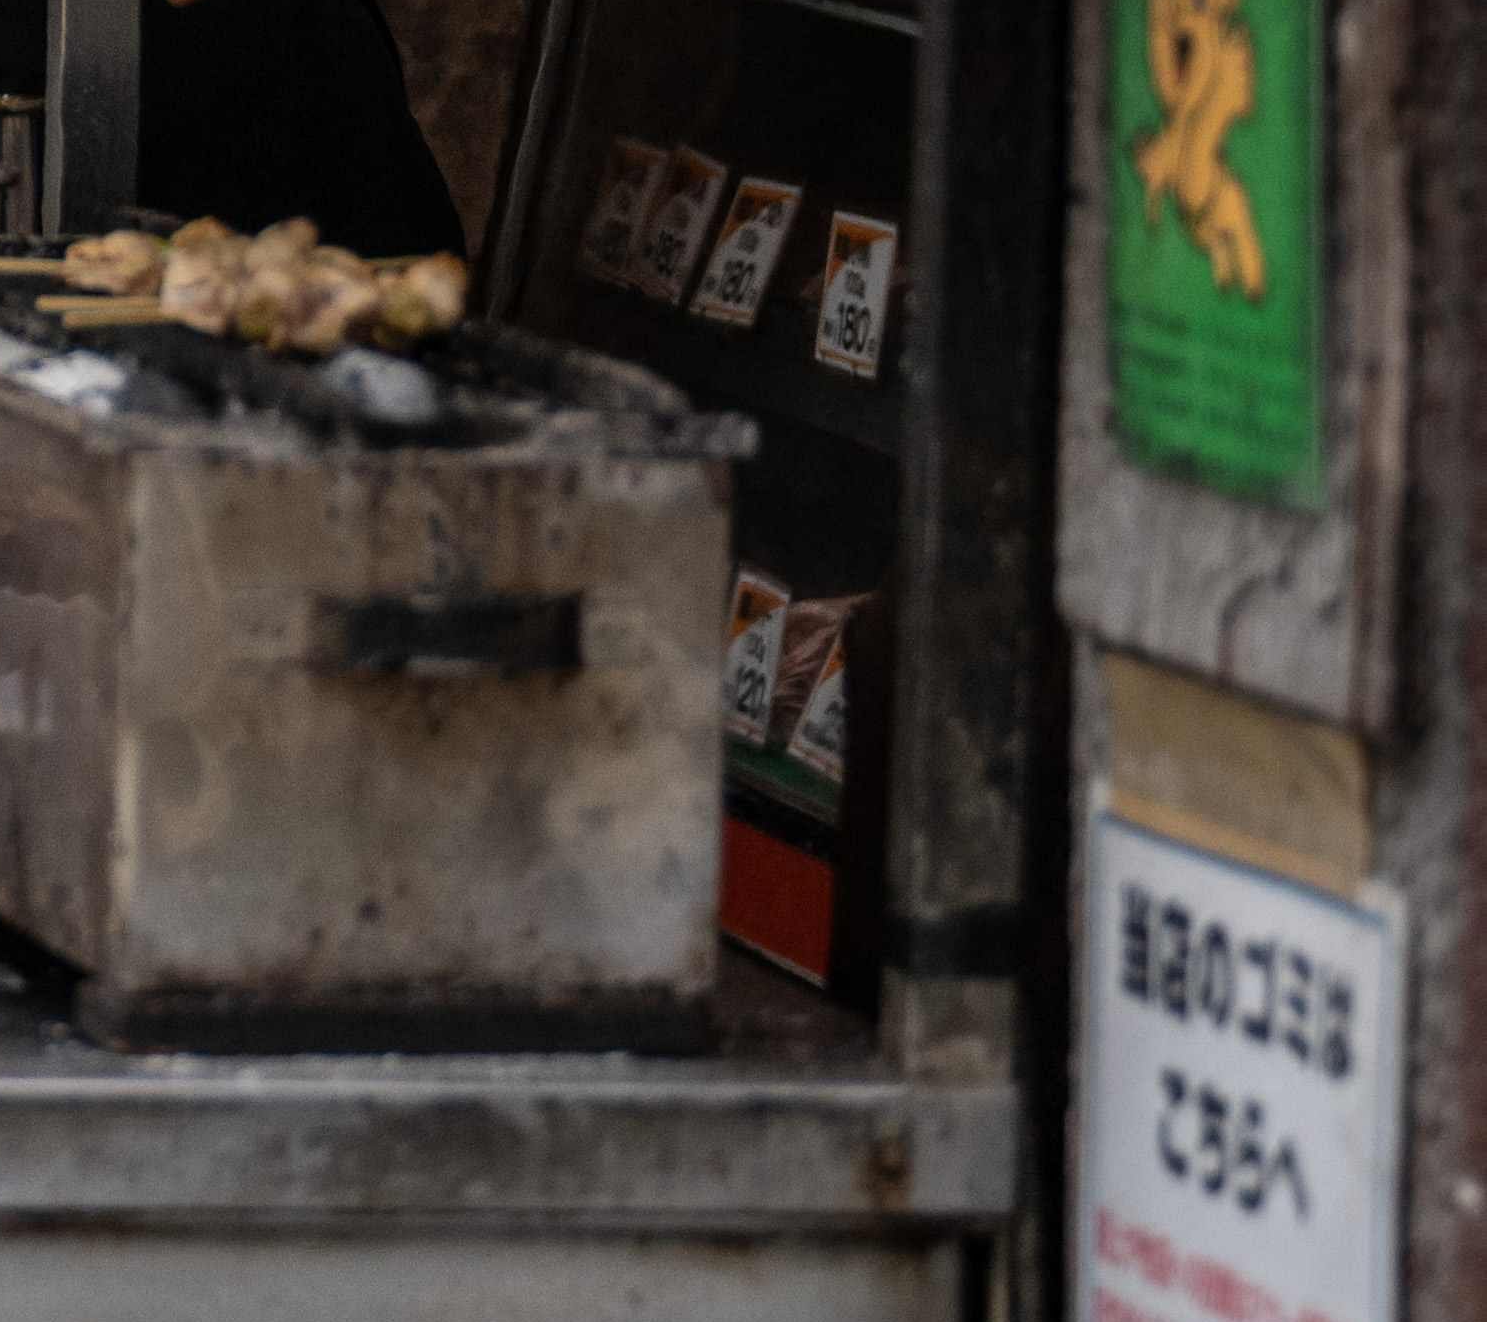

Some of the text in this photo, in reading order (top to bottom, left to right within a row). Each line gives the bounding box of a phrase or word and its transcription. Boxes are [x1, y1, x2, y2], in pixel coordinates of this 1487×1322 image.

[837, 301, 870, 353] 180
[1121, 883, 1355, 1080] 当店のゴミは
[1157, 1066, 1311, 1223] こちらへ
